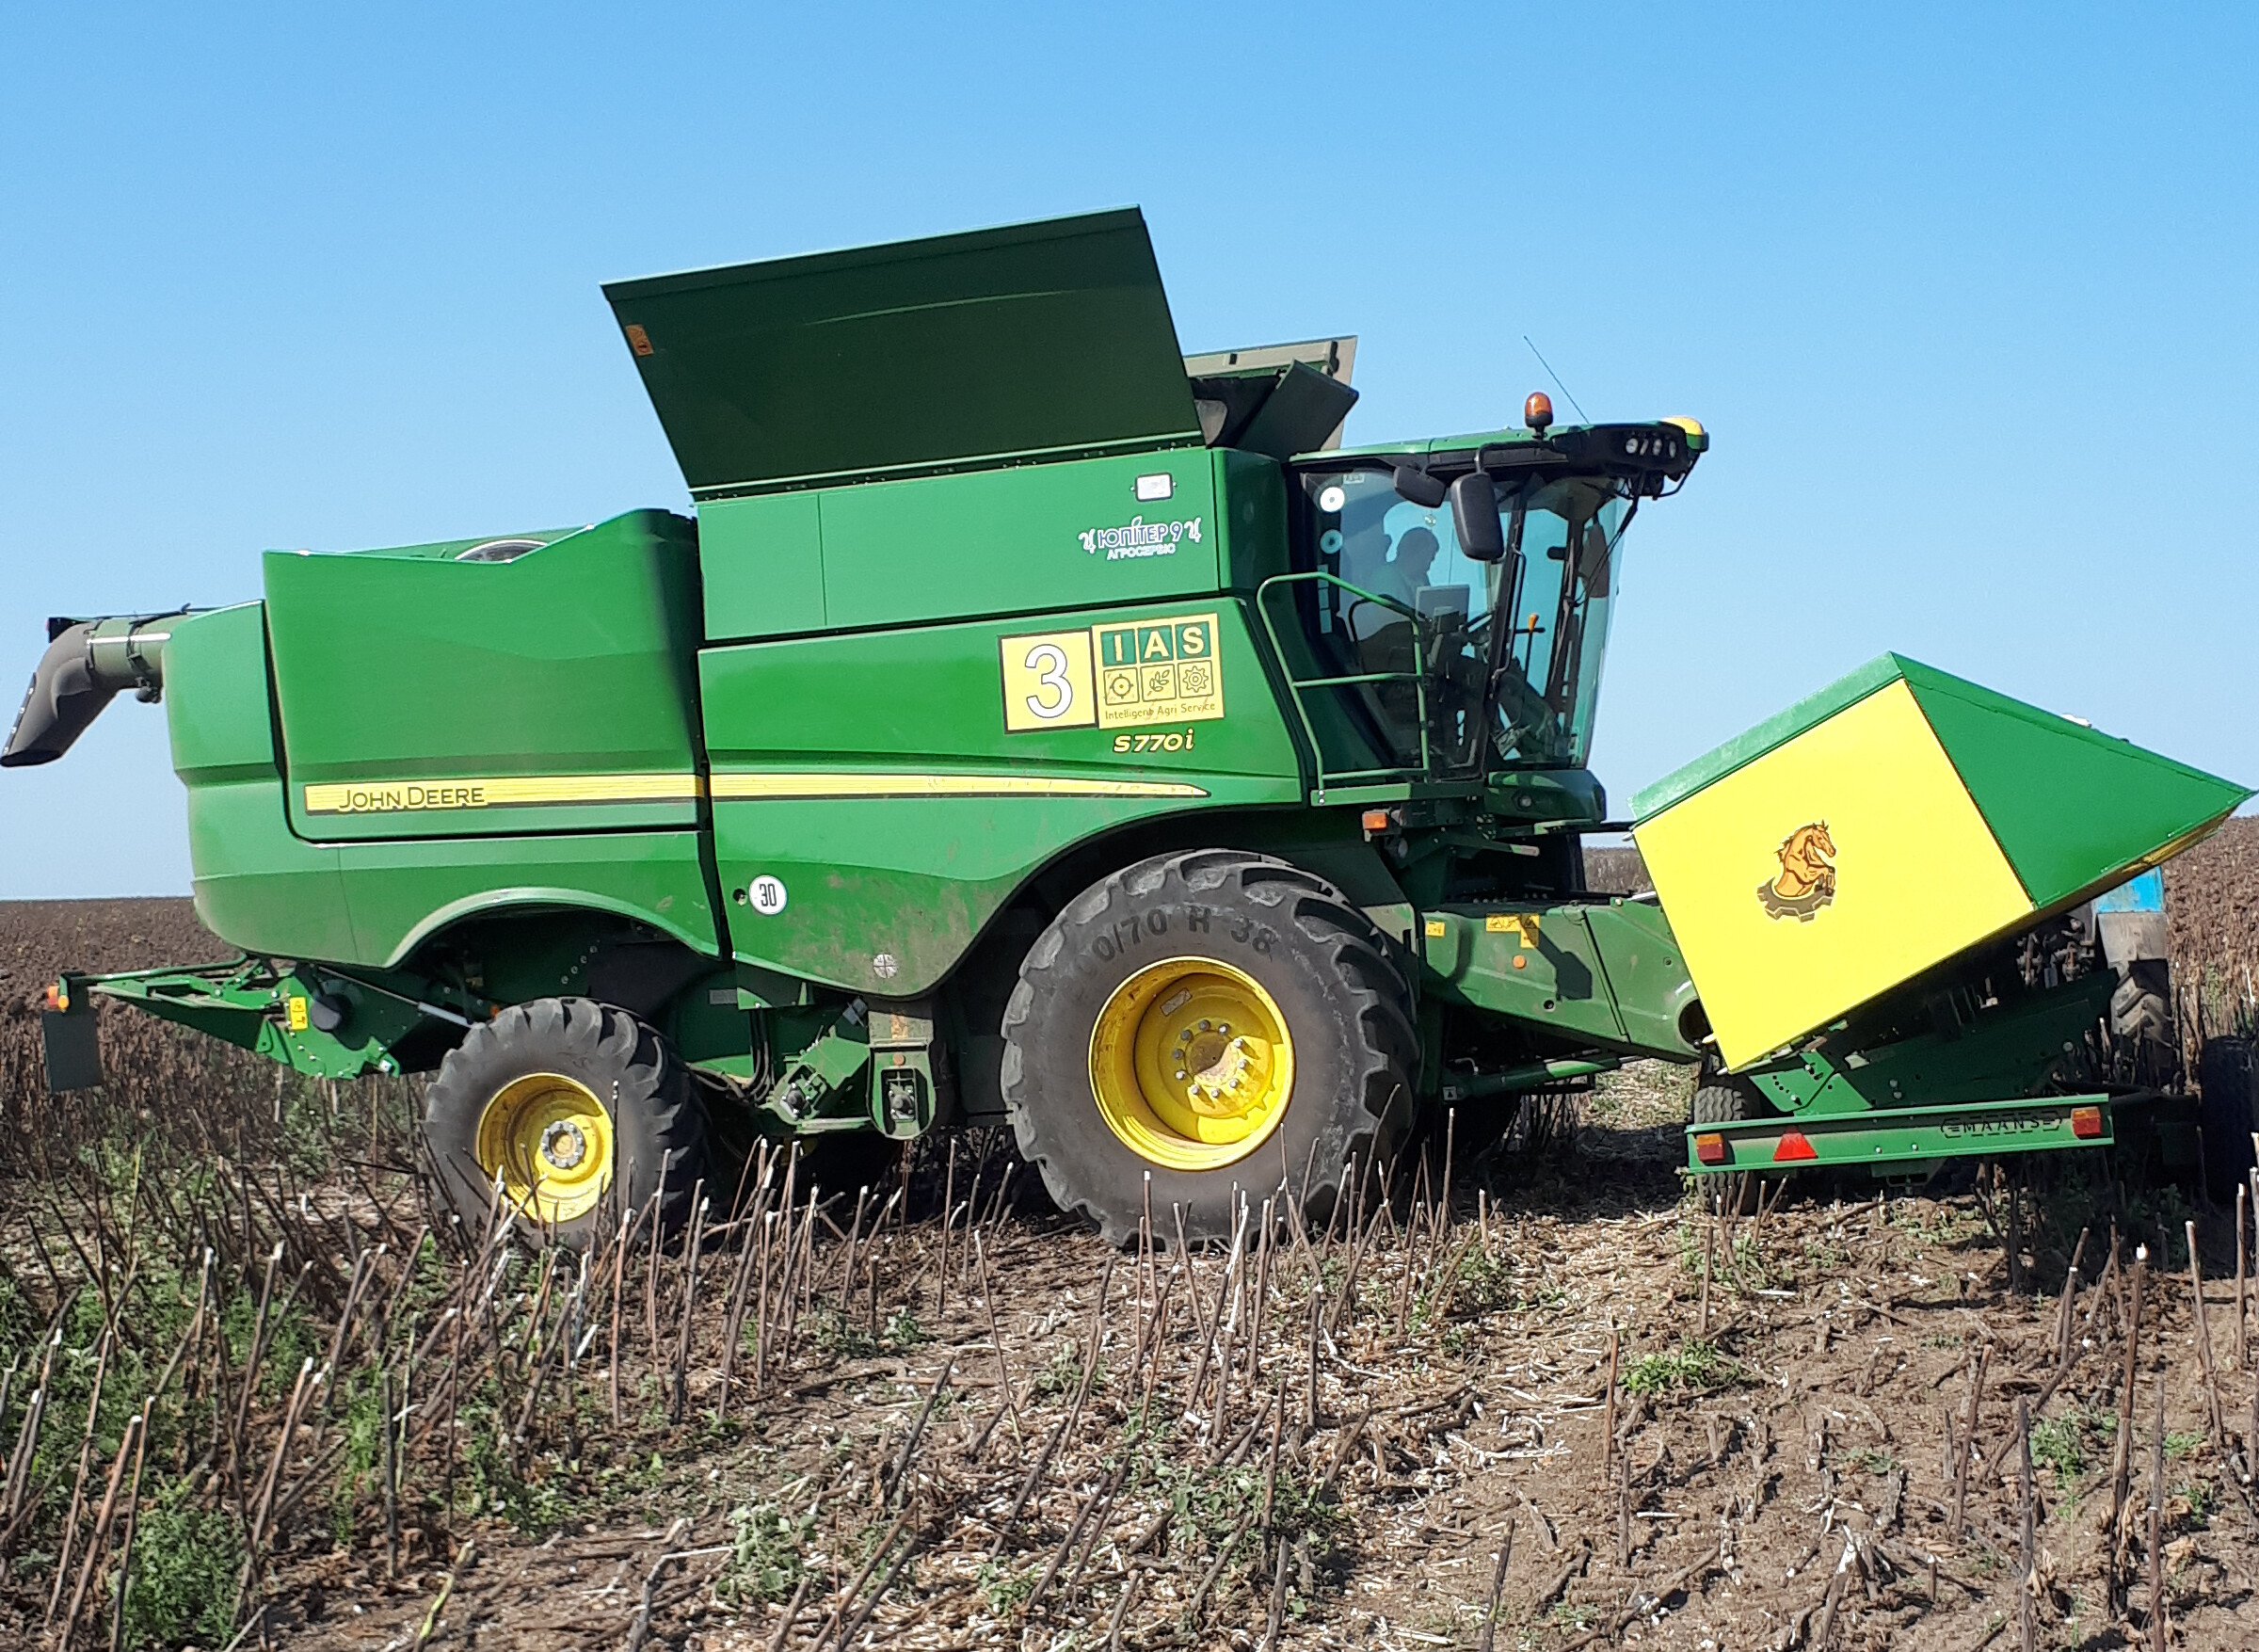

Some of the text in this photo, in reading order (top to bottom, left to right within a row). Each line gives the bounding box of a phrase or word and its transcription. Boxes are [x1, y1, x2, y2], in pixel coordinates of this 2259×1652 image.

[1097, 521, 1183, 549] ЮПІТЕР 9
[1114, 626, 1206, 663] IAS
[1025, 643, 1074, 719] 3
[1105, 702, 1216, 721] Intelligent Agri Service
[1113, 727, 1195, 753] S770i
[338, 786, 486, 810] JOHN DEERE
[759, 883, 777, 907] 30
